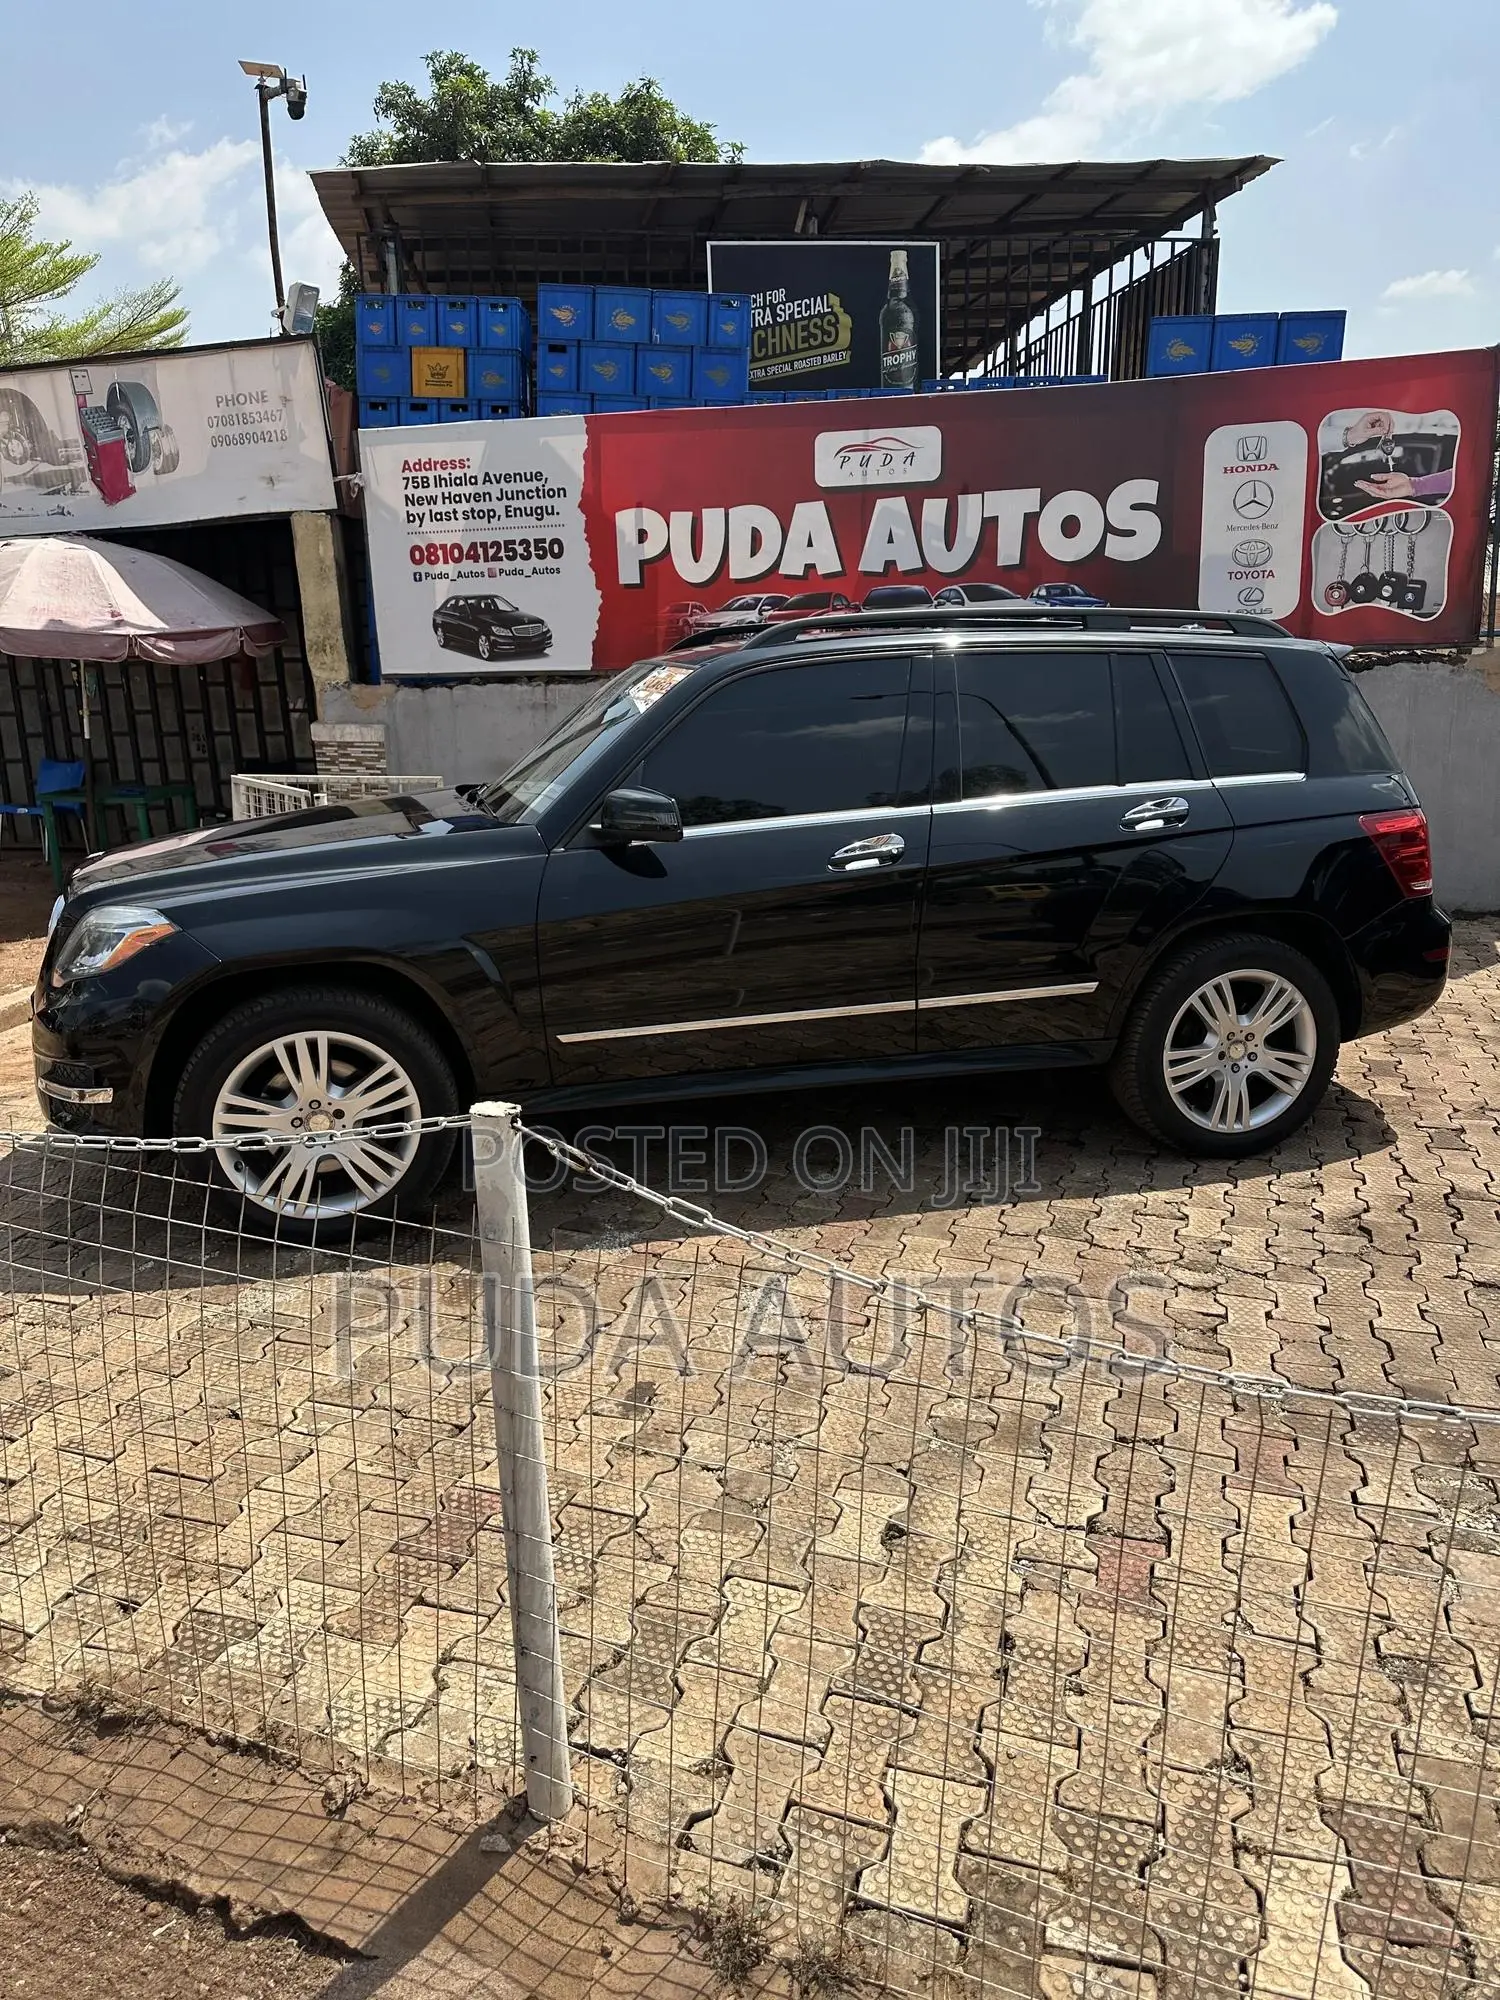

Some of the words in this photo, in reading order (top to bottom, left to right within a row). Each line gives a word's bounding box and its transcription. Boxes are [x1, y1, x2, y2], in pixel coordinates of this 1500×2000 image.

[766, 288, 786, 306] FOR
[750, 306, 773, 328] TRA
[776, 294, 832, 323] SPECIAL
[753, 314, 836, 358] CHNESS
[767, 362, 793, 376] SPECIAL
[794, 357, 822, 370] ROASTED
[823, 351, 847, 364] BARLEY
[883, 350, 917, 367] TROPHY
[216, 390, 269, 408] PHONE
[207, 409, 283, 429] 07081853467
[211, 429, 288, 448] 09068904218
[401, 457, 472, 473] Address:
[840, 451, 916, 470] PUDA
[1223, 463, 1279, 474] HONDA
[402, 475, 431, 490] 75B
[433, 472, 478, 489] Ihiala
[482, 470, 549, 485] Avenue,
[849, 468, 908, 478] AUTOS
[404, 493, 438, 507] New
[441, 491, 492, 505] Haven
[496, 484, 567, 502] Junction
[406, 510, 426, 528] by
[429, 508, 459, 522] last
[462, 507, 501, 524] stop,
[505, 504, 560, 521] Enugu.
[615, 500, 844, 587] PUDA
[858, 478, 1163, 574] AUTOS
[1225, 523, 1279, 533] Mercedes-Benz
[409, 537, 565, 566] 08104125350
[424, 569, 485, 582] Puda_Autos
[499, 566, 561, 579] Puda_Autos
[1227, 569, 1275, 580] TOYOTA
[1226, 607, 1273, 615] EXUS
